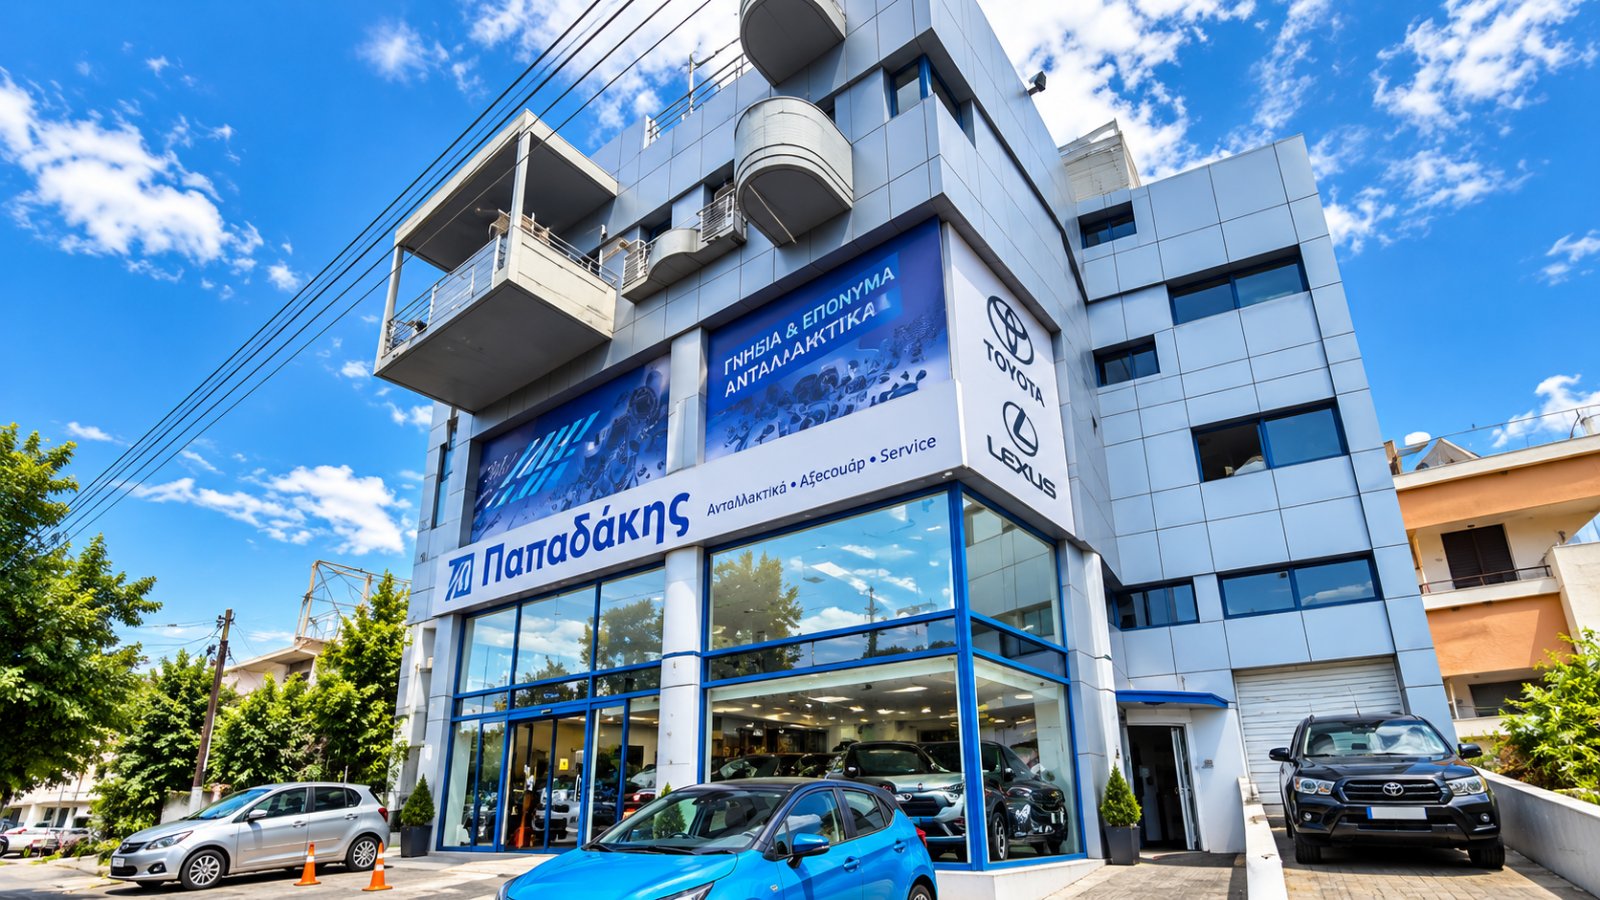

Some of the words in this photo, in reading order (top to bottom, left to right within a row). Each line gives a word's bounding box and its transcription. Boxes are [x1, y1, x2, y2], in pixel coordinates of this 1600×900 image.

[786, 322, 798, 339] &
[803, 266, 895, 330] ΕΠΟΝΥΜΑ
[983, 338, 1045, 408] TOYOTA
[880, 436, 937, 463] Service
[987, 434, 1056, 499] LEXUS
[482, 492, 690, 586] Παπαδάκης
